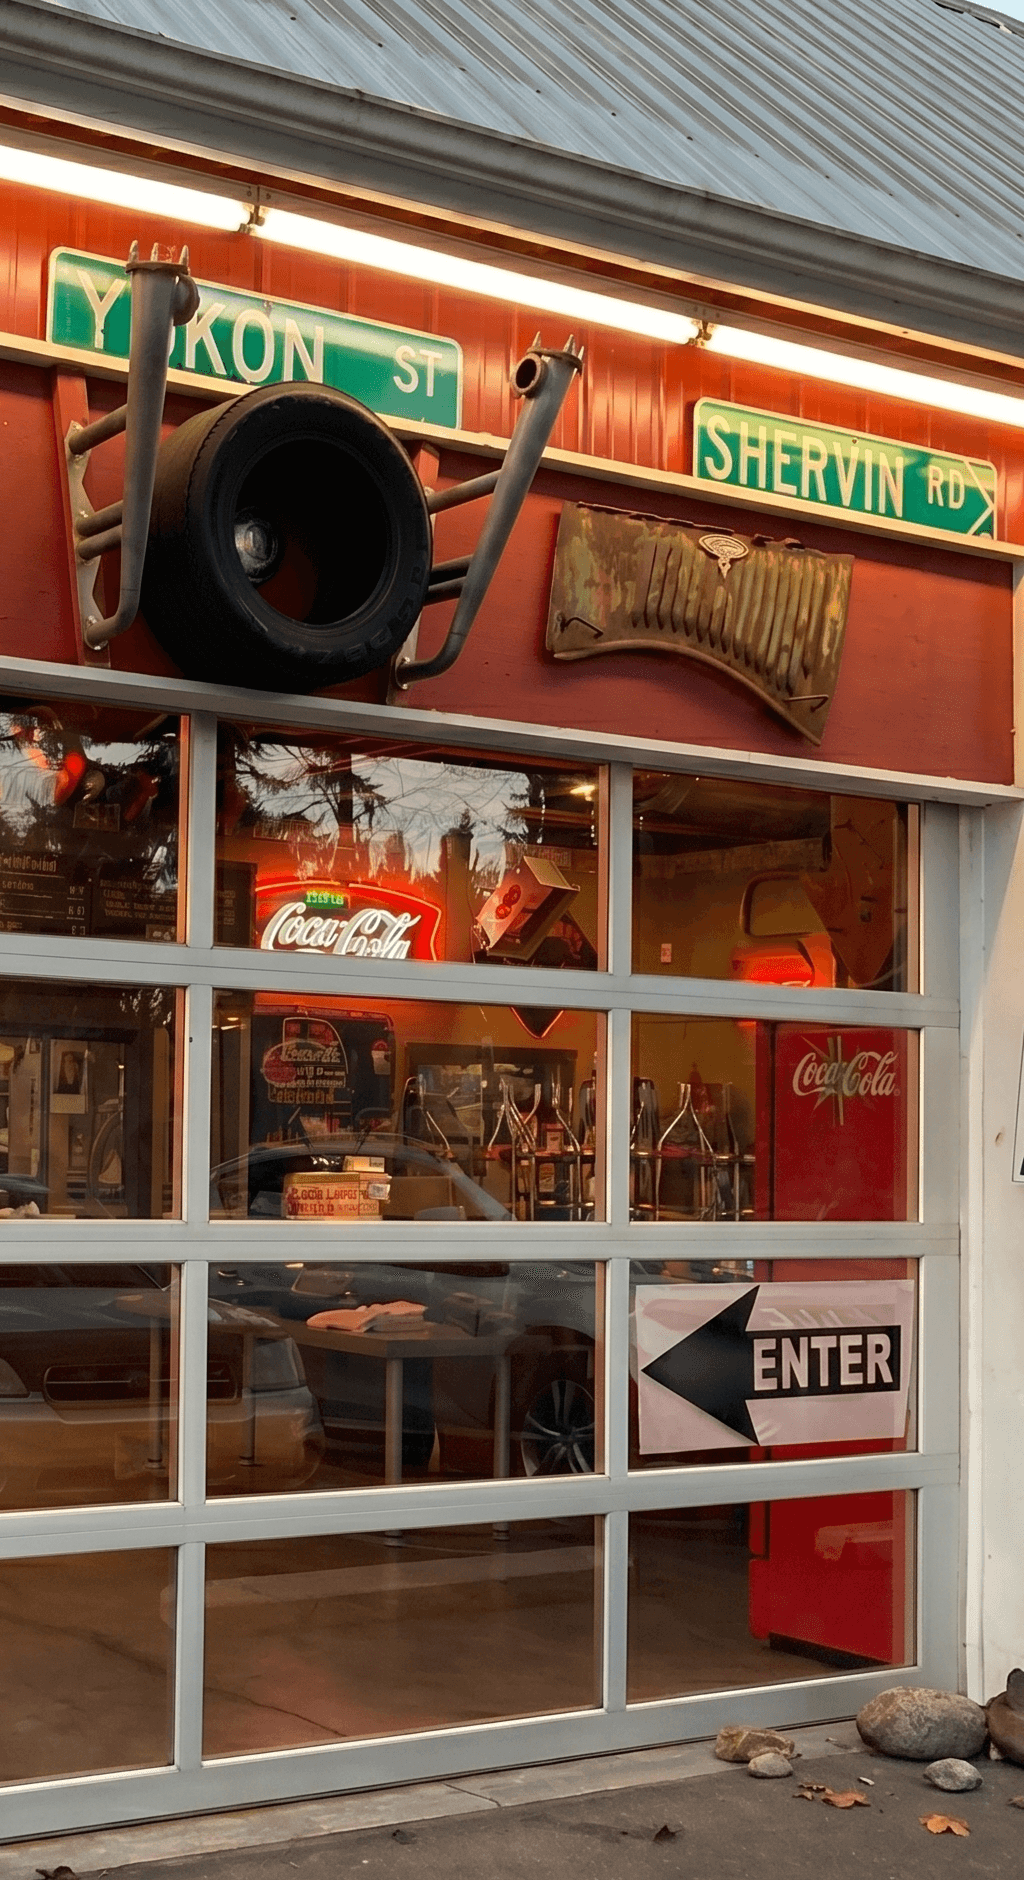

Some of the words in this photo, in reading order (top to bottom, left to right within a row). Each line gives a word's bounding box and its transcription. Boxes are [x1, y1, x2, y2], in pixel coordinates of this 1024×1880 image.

[77, 268, 325, 384] YKON
[392, 344, 443, 398] ST
[703, 414, 904, 518] SHERVIN
[927, 463, 965, 510] RD
[792, 1051, 899, 1097] Coca-Cola
[753, 1333, 894, 1391] ENTER
